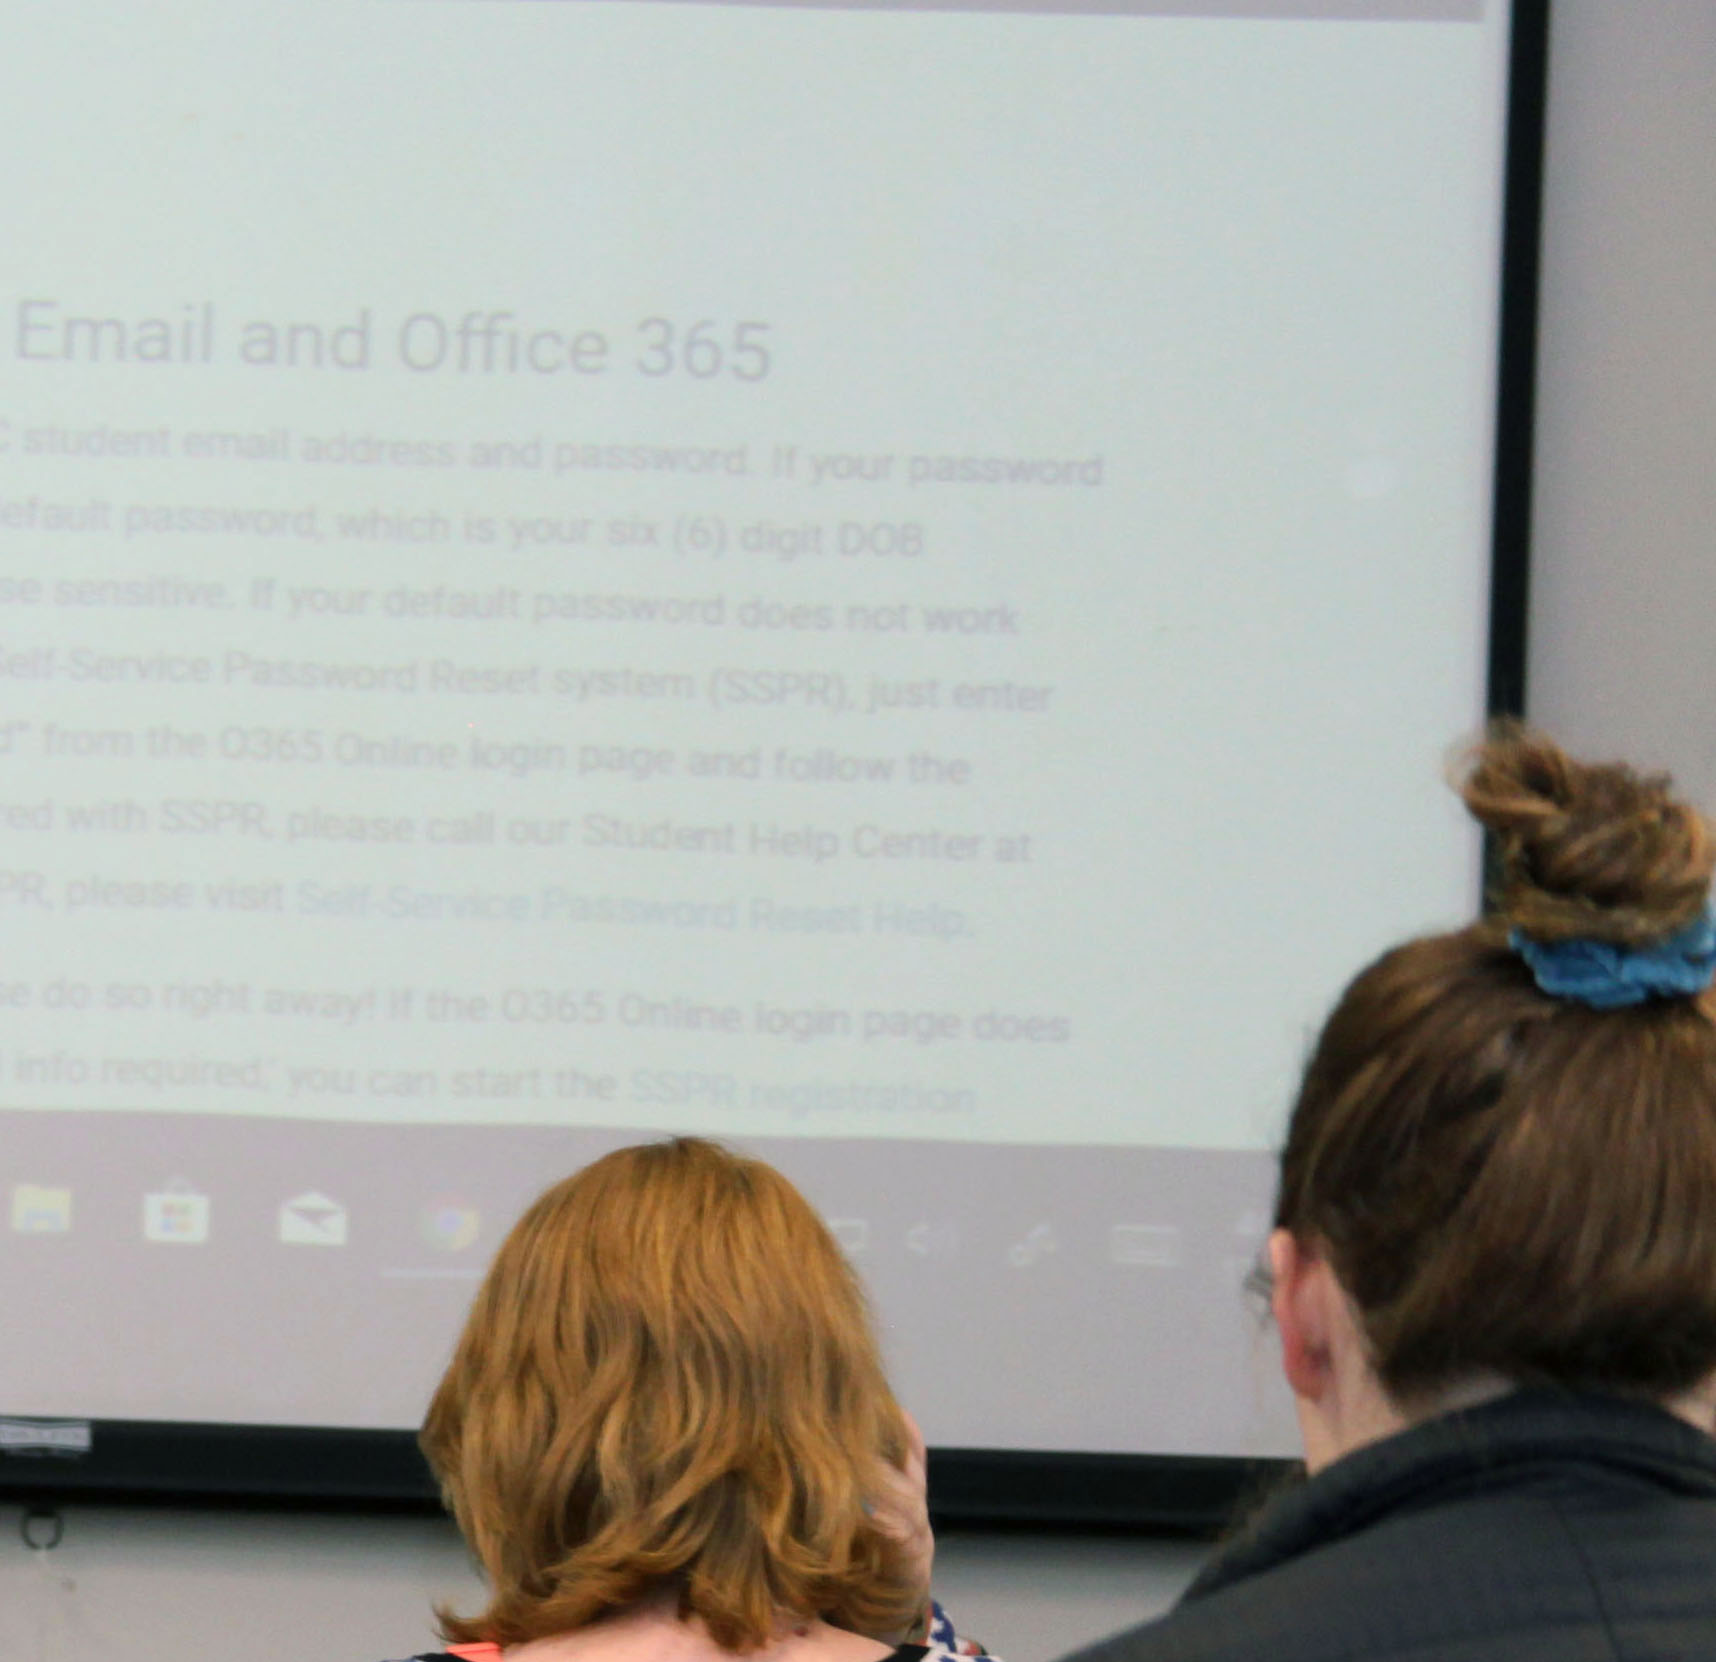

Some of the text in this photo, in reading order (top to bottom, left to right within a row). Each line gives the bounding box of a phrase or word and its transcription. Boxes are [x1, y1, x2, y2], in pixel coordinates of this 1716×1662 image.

[14, 298, 216, 364] Email
[239, 308, 374, 369] and
[396, 310, 610, 376] Office
[636, 318, 773, 381] 365
[21, 421, 171, 458] student
[182, 427, 291, 462] email
[301, 429, 457, 467] address
[468, 435, 544, 470] and
[808, 452, 897, 489] your
[903, 453, 1106, 492] password
[335, 506, 452, 542] which
[462, 509, 498, 544] is
[505, 518, 594, 555] your
[604, 514, 661, 549] six
[737, 518, 825, 563] digit
[835, 521, 928, 557] DOB
[286, 586, 373, 623] your
[380, 581, 524, 619] default
[529, 591, 728, 630] password
[734, 592, 835, 629] does
[843, 600, 912, 631] not
[918, 600, 1021, 635] work
[220, 651, 420, 691] Password
[427, 658, 543, 696] Reset
[550, 668, 697, 707] system
[865, 673, 942, 717] just
[950, 680, 1054, 712] enter
[42, 720, 133, 757] from
[145, 724, 207, 759] the
[334, 730, 460, 768] Online
[466, 735, 568, 780] login
[575, 746, 675, 785] page
[686, 744, 762, 779] and
[773, 745, 896, 783] follow
[906, 751, 972, 786] the
[64, 798, 149, 833] with
[285, 805, 416, 849] please
[425, 811, 497, 845] call
[505, 819, 571, 848] our
[581, 815, 737, 854] Student
[746, 820, 841, 867] Help
[848, 824, 984, 862] Center
[992, 833, 1034, 864] at
[63, 872, 195, 916] please
[203, 877, 284, 913] visit
[41, 973, 91, 1008] do
[103, 983, 153, 1011] so
[161, 978, 252, 1023] right
[424, 988, 490, 1023] the
[617, 994, 744, 1032] Online
[751, 999, 853, 1045] login
[860, 1010, 964, 1049] page
[970, 1007, 1072, 1044] does
